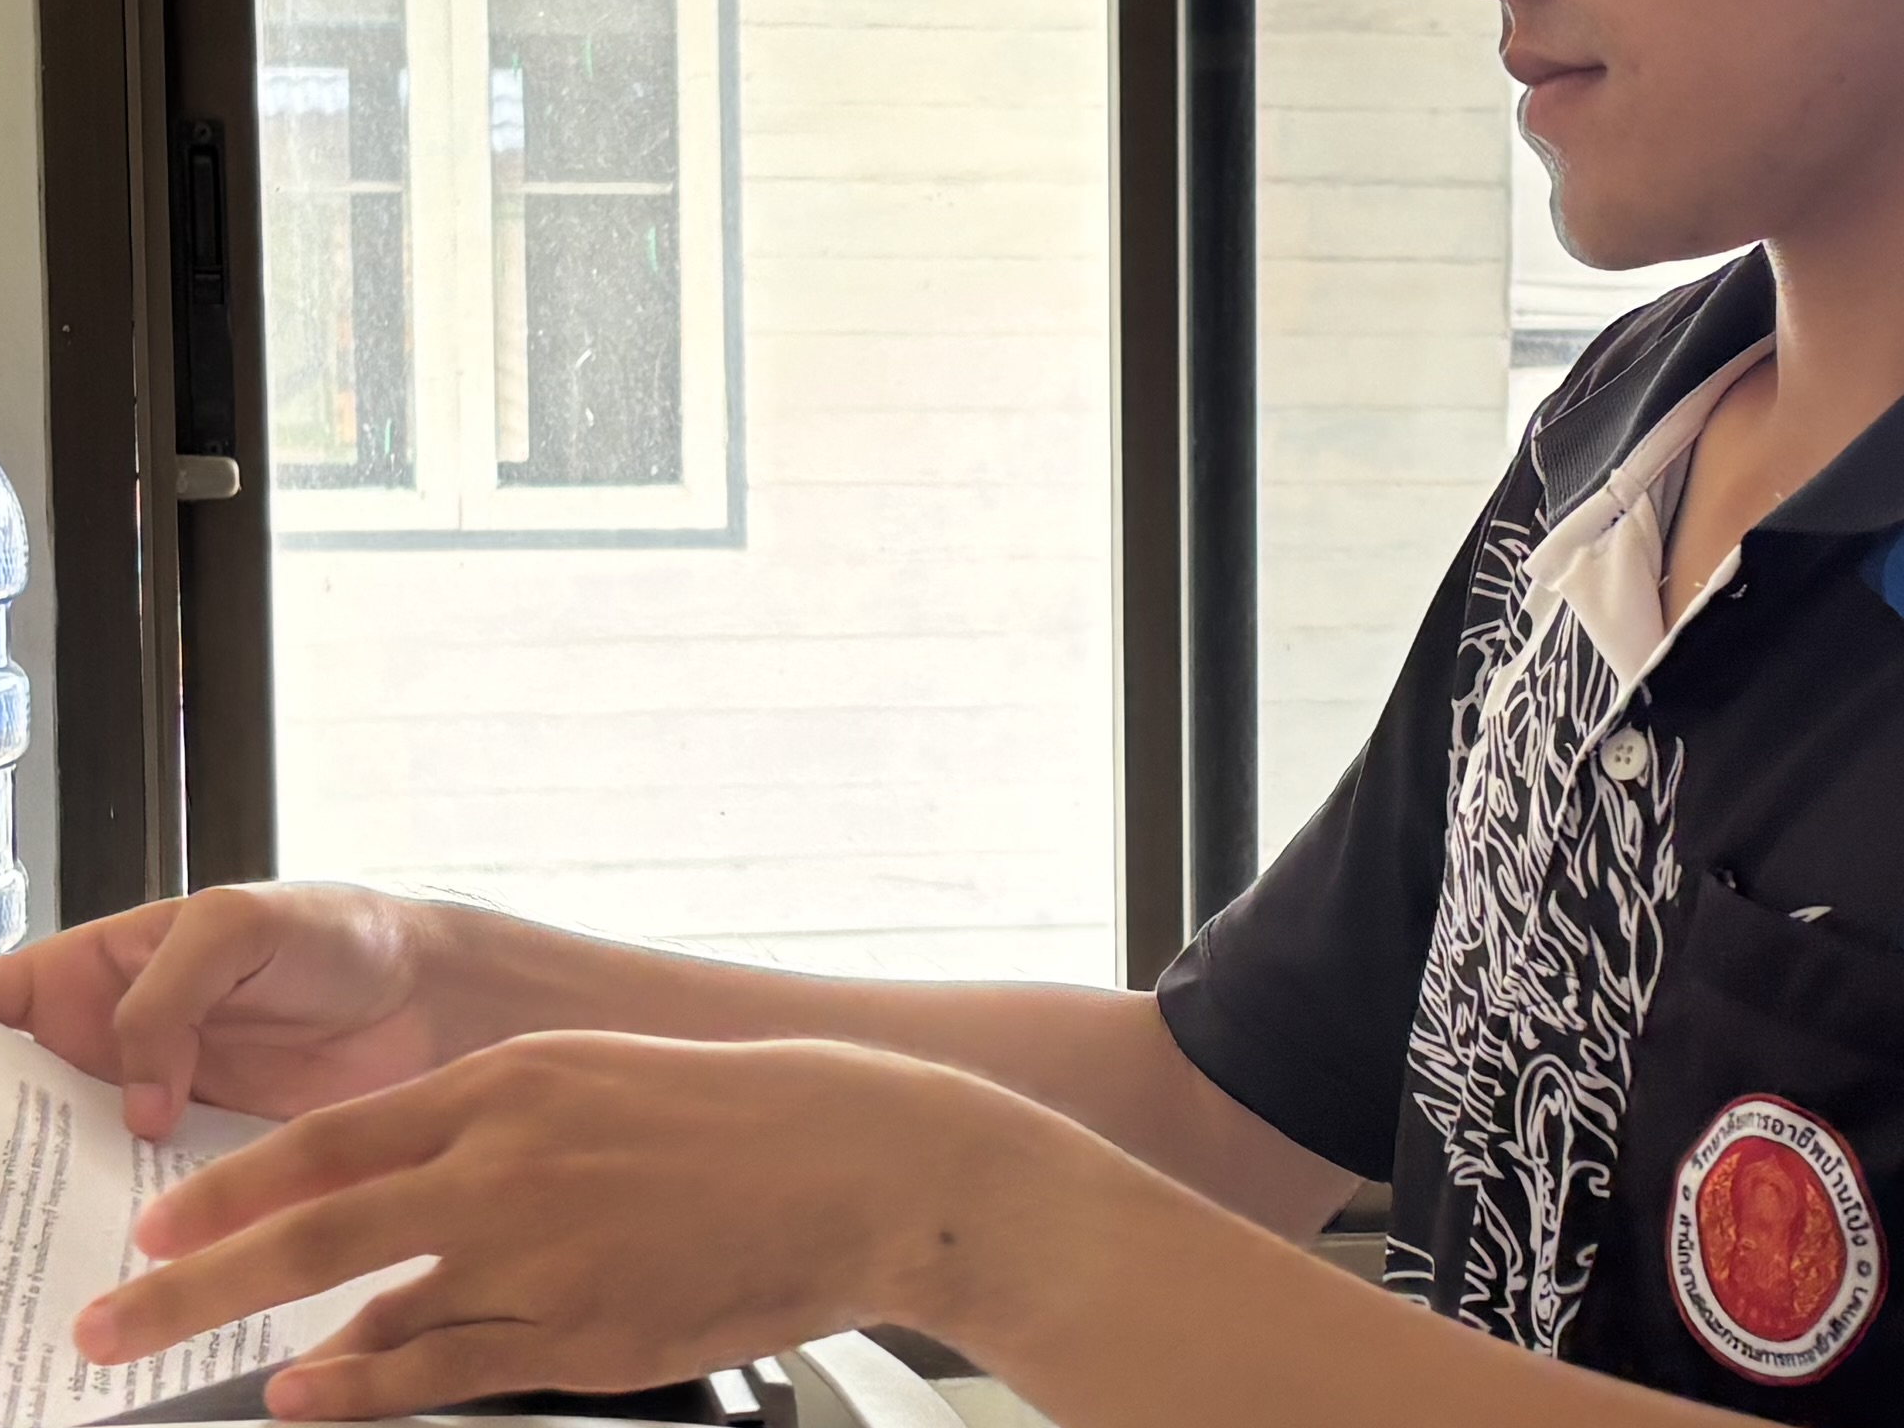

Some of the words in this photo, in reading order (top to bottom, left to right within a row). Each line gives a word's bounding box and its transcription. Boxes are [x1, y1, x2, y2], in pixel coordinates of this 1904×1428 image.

[1690, 1109, 1868, 1248] วิทยาลัยการอาชีพบ้านโป่ง
